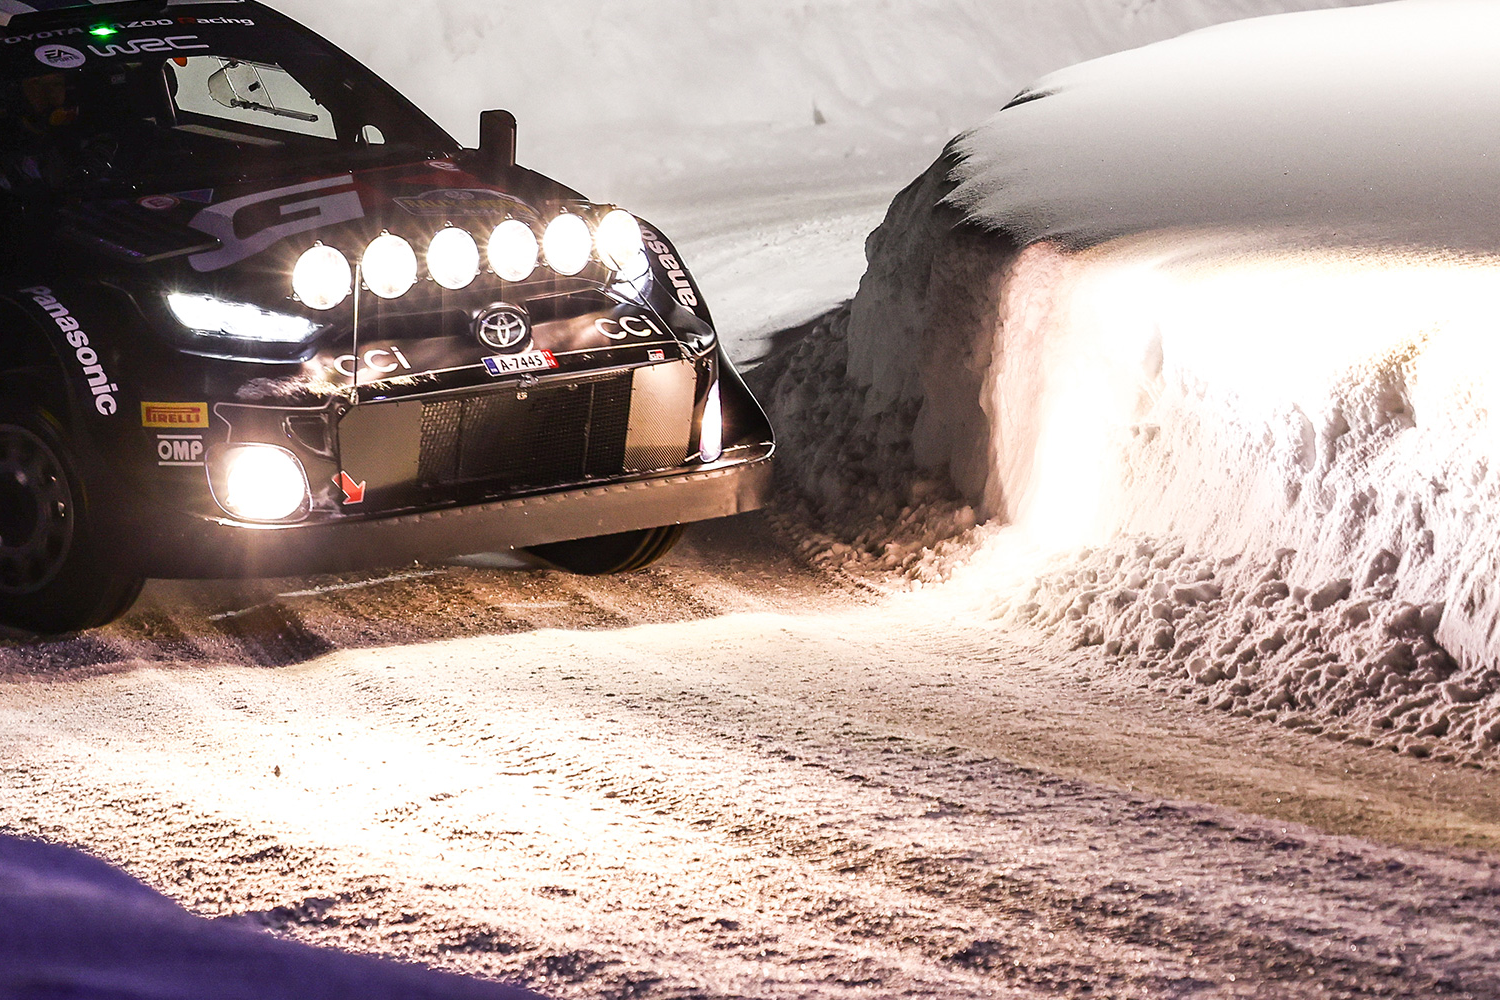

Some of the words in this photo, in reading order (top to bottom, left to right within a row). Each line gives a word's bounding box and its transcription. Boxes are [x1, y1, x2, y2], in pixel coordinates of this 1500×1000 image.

[87, 34, 210, 57] WRC
[499, 354, 543, 371] A-7445
[145, 406, 201, 424] PIRELLI
[157, 440, 204, 461] OMP
